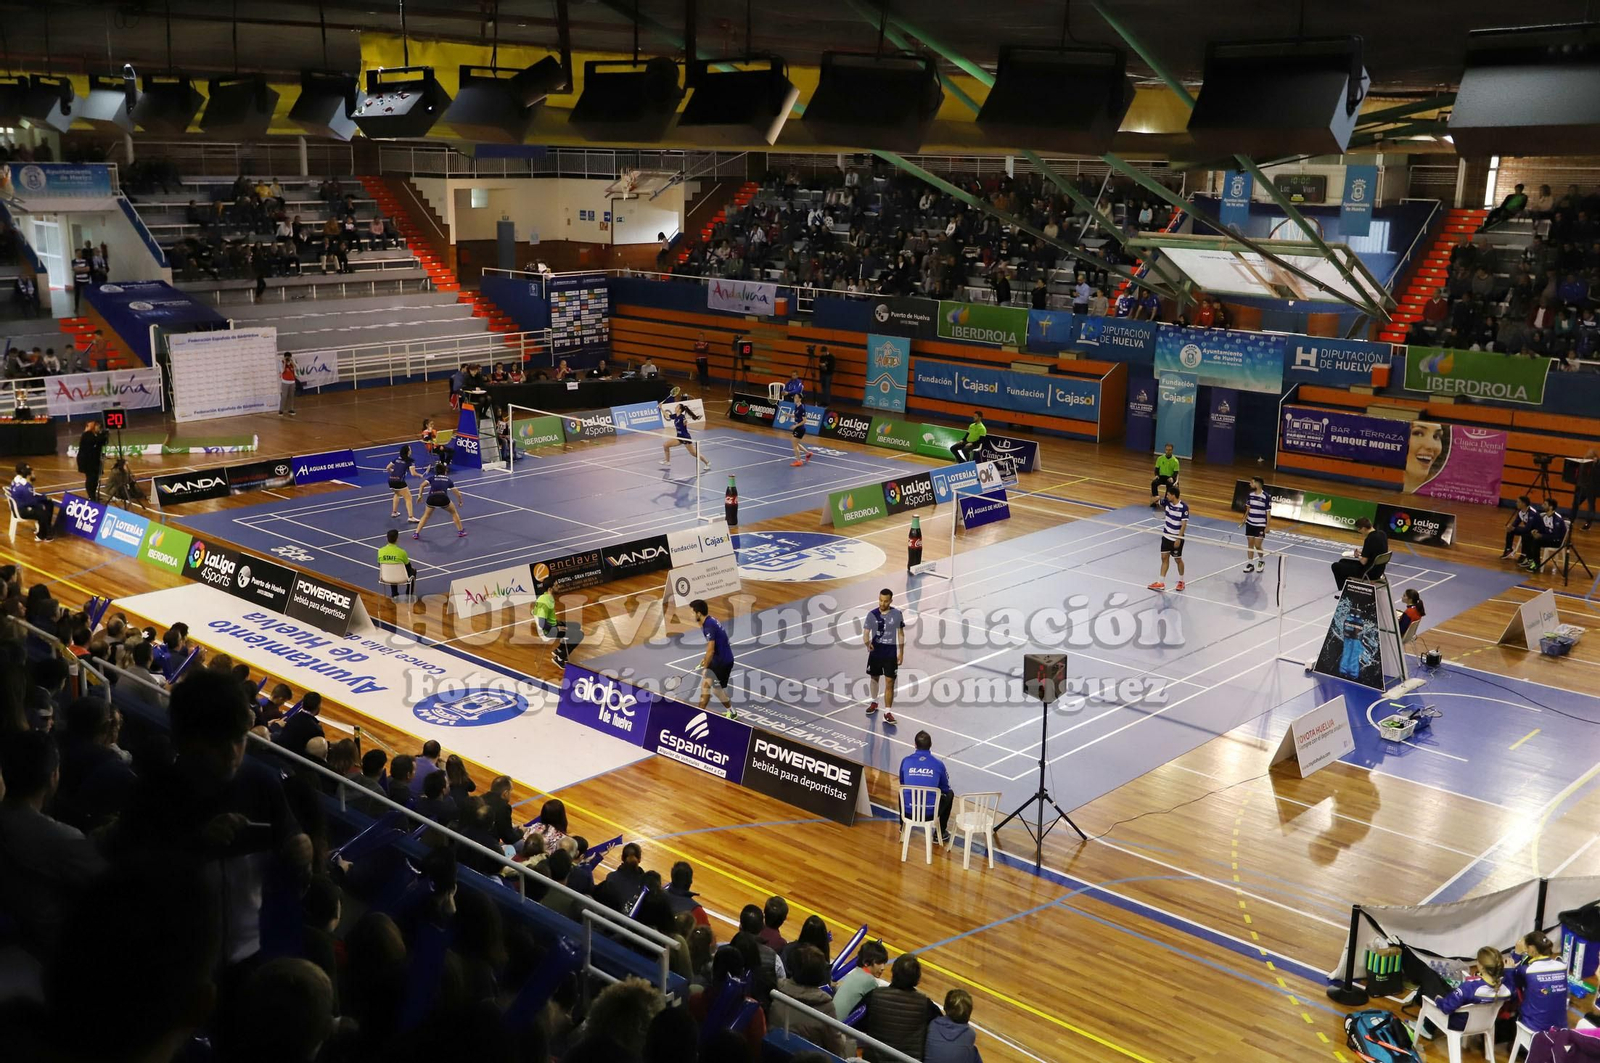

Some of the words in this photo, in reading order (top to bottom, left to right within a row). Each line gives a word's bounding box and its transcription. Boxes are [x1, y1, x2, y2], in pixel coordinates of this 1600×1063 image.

[712, 280, 770, 305] Andalucía
[952, 325, 1017, 344] IBERDROLA
[1102, 325, 1150, 340] DIPUTACIÓN
[1100, 335, 1110, 344] DE
[1112, 335, 1144, 348] HUELVA
[1202, 348, 1243, 358] Ayuntamiento
[1320, 348, 1384, 364] DIPUTACIÓN
[1320, 359, 1332, 370] DE
[918, 374, 952, 386] Fundación
[962, 378, 998, 394] Cajasol
[1162, 378, 1194, 388] Fundación
[1426, 376, 1528, 400] IBERDROLA
[55, 375, 152, 402] Andalucía
[1006, 386, 1045, 399] Fundación
[1056, 390, 1094, 406] Cajasol
[1162, 392, 1194, 404] Cajasol
[628, 407, 658, 418] LOTERÍAS
[749, 404, 776, 415] POMODORO
[107, 413, 123, 426] 20
[582, 414, 612, 428] LaLiga
[839, 417, 869, 431] LaLiga
[585, 424, 614, 436] 4Sports
[837, 427, 866, 440] 4Sports
[1330, 426, 1350, 434] BAR
[1360, 429, 1404, 442] TERRAZA
[524, 434, 559, 446] IBERDROLA
[876, 436, 910, 448] IBERDROLA
[1286, 439, 1322, 448] HUELVA
[1330, 434, 1368, 447] PARQUE
[1368, 440, 1403, 452] MORET
[1454, 437, 1479, 448] Clínica
[1480, 440, 1504, 450] Dental
[309, 464, 327, 473] AGUAS
[335, 460, 355, 469] HUELVA
[1005, 453, 1026, 464] Dntal
[947, 469, 977, 483] LOTERÍAS
[161, 476, 226, 494] VANDA
[901, 479, 931, 496] LaLiga
[904, 491, 933, 507] 4Sports
[844, 506, 880, 522] IBERDROLA
[974, 506, 987, 514] AGUAS
[988, 504, 993, 512] DE
[1312, 512, 1356, 526] IBERDRO
[1413, 518, 1439, 530] LaLiga
[116, 520, 144, 538] LOTERÍAS
[1412, 526, 1438, 536] 4Sports
[670, 543, 697, 554] Fundación
[705, 533, 730, 548] Cajasol
[147, 548, 178, 568] IBERDROLA
[204, 550, 236, 574] LaLiga
[549, 552, 598, 570] enclave
[606, 545, 669, 566] VANDA
[201, 566, 231, 588] 4Sports
[251, 576, 264, 588] Puerto
[265, 582, 271, 590] de
[271, 584, 286, 596] Huelva
[465, 578, 527, 605] Andalucía
[297, 580, 351, 610] POWERADE
[294, 594, 309, 606] bebida
[309, 598, 320, 611] para
[320, 603, 346, 621] deportistas
[242, 612, 333, 650] Huelva
[208, 620, 389, 694] Ayuntamiento
[329, 646, 369, 662] de
[604, 710, 611, 724] de
[612, 716, 633, 732] Huelva
[749, 704, 804, 725] deportistas
[735, 707, 857, 754] POWERADE
[806, 722, 829, 734] para
[1297, 728, 1316, 745] TOYOTA
[1316, 718, 1335, 734] HUELVA
[659, 728, 729, 766] Espanicar
[832, 732, 868, 748] bebida
[754, 739, 850, 786] POWERADE
[752, 759, 779, 777] bebida
[780, 768, 798, 784] para
[800, 774, 847, 802] deportistas
